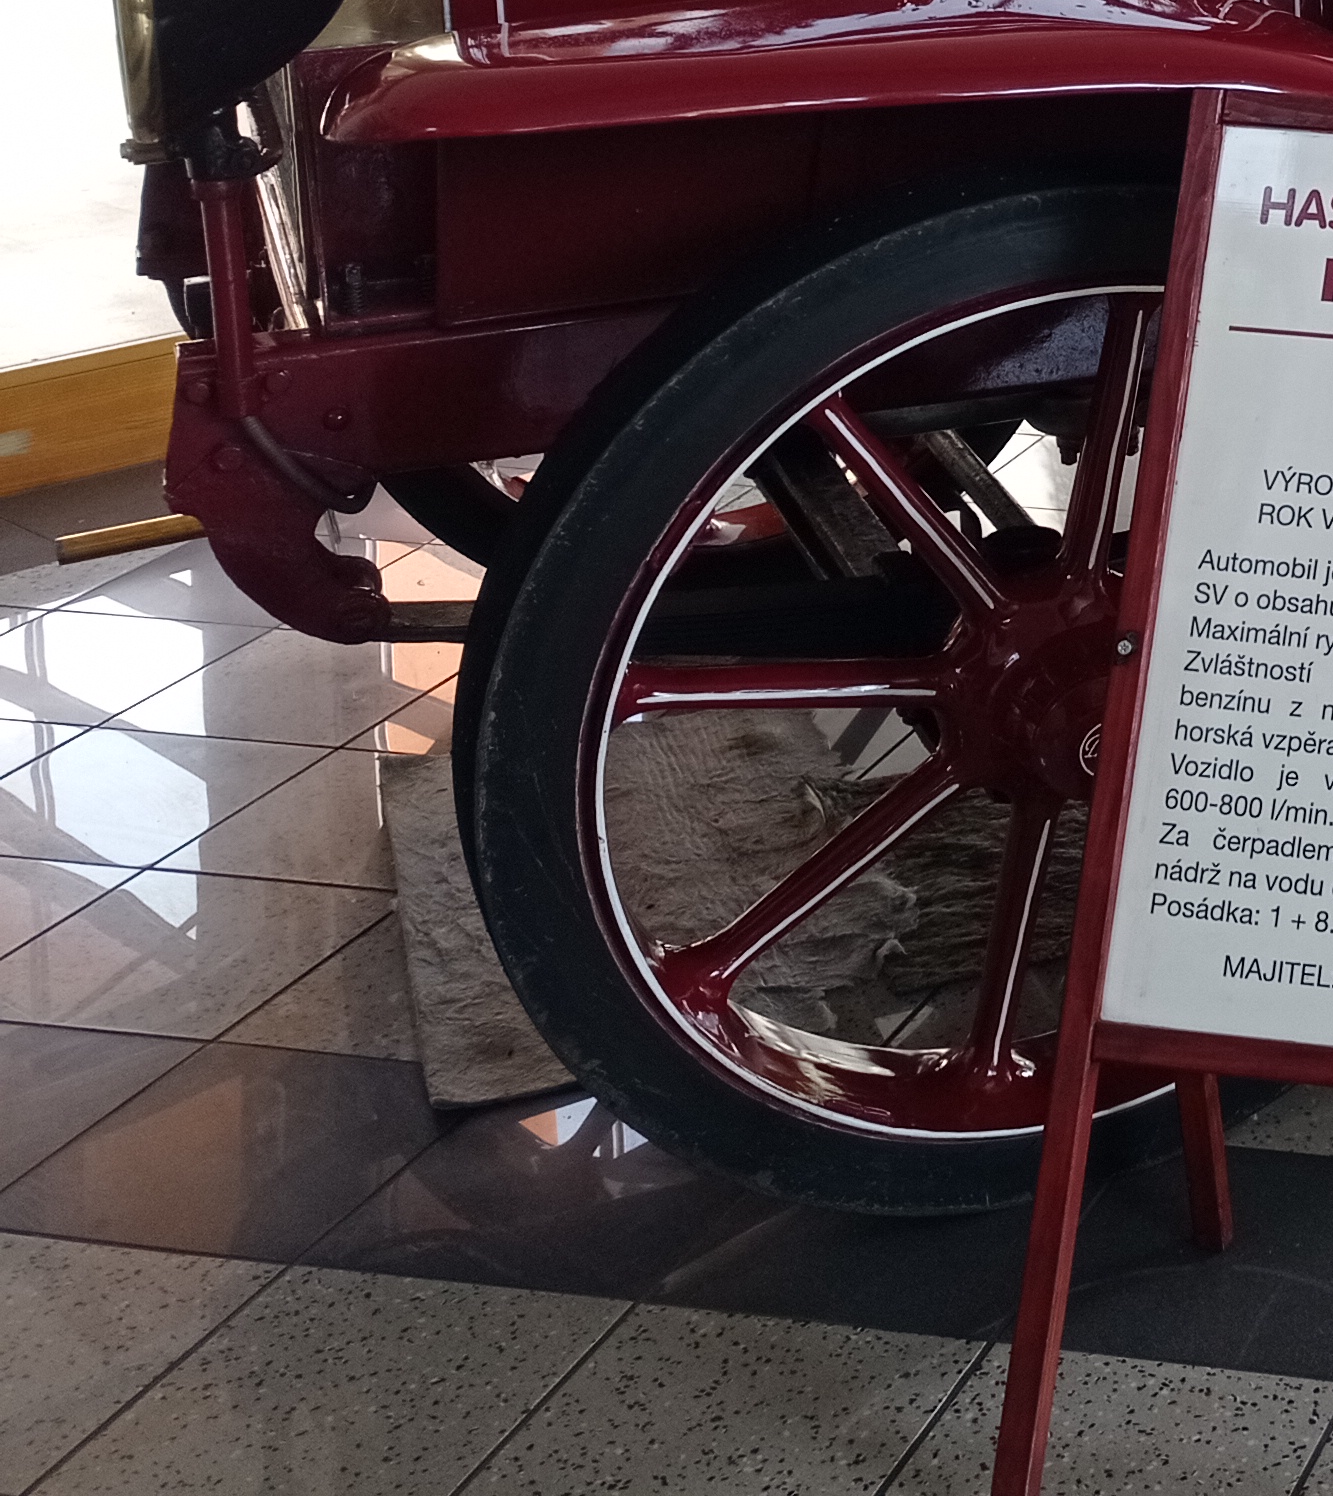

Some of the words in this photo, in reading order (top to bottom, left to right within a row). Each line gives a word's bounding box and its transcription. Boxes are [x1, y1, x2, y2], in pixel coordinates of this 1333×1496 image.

[1257, 502, 1315, 529] ROK
[1197, 548, 1319, 581] Automobil
[1194, 581, 1229, 606] SV
[1234, 591, 1249, 608] o
[1189, 615, 1311, 649] Maximální
[1183, 649, 1315, 684] Zvláštností
[1179, 683, 1272, 715] benzínu
[1288, 700, 1304, 718] z
[1174, 718, 1254, 748] horská
[1170, 752, 1254, 783] Vozidlo
[1275, 763, 1299, 792] je
[1164, 787, 1263, 819] 600-800
[1270, 798, 1333, 827] l/min.
[1158, 821, 1190, 848] Za
[1154, 858, 1222, 886] nádrž
[1228, 870, 1257, 890] na
[1265, 872, 1324, 897] vodu
[1149, 892, 1261, 926] Posádka:
